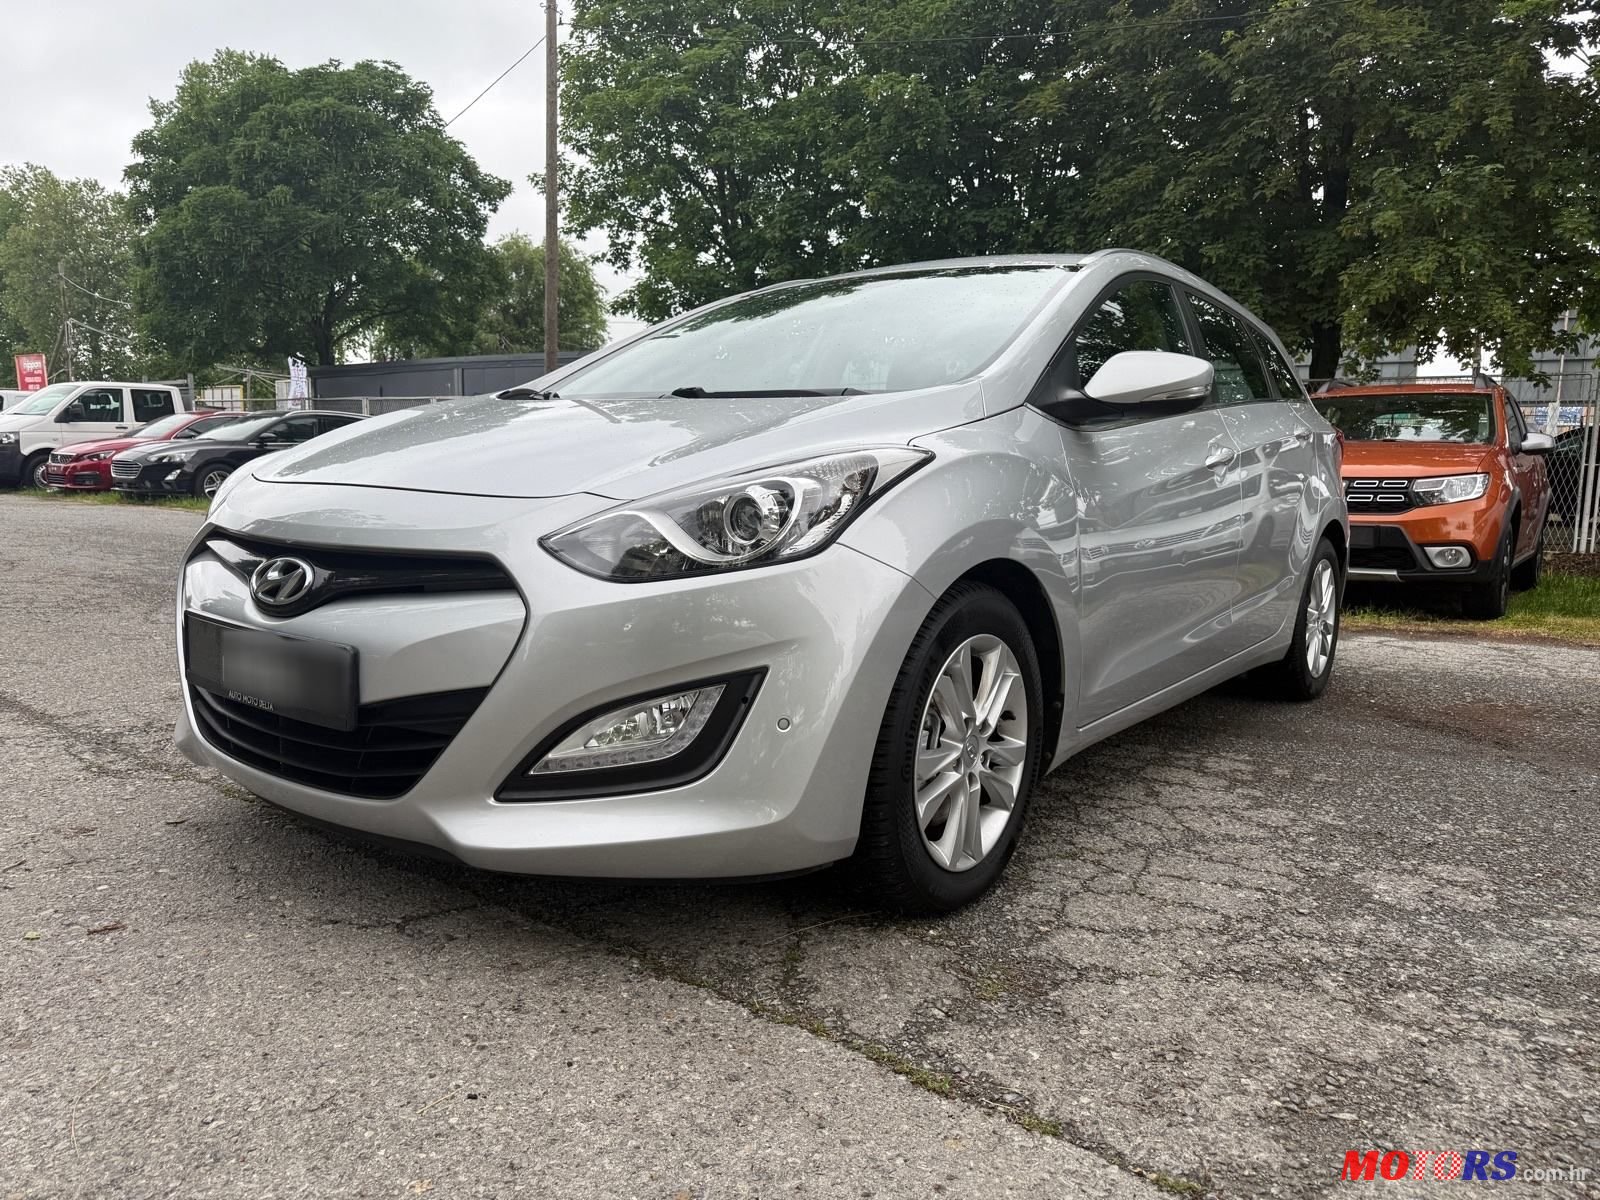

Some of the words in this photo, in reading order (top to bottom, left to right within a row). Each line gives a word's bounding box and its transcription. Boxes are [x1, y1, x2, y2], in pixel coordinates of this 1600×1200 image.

[228, 689, 242, 701] AUTO
[242, 695, 258, 706] MOTO
[259, 699, 274, 711] DELTA
